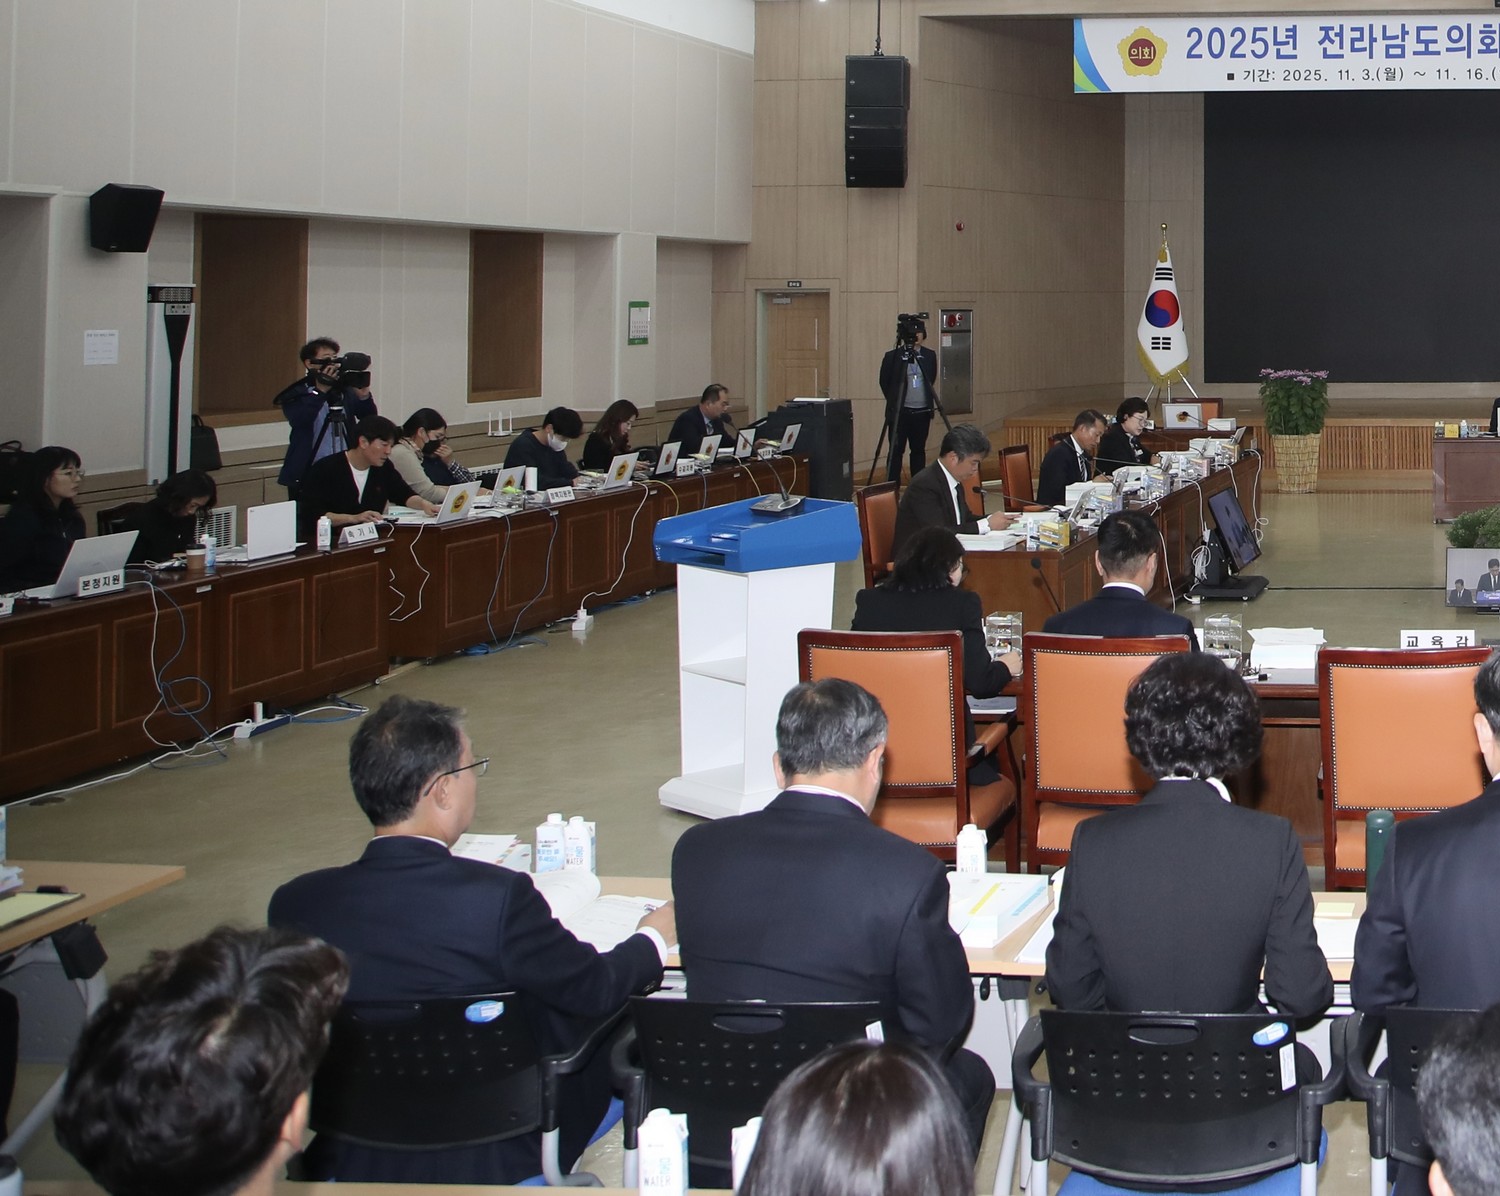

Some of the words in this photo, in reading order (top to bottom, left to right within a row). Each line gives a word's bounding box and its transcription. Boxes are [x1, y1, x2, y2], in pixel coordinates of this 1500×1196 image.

[1186, 24, 1298, 60] 2025년
[1129, 46, 1155, 60] 의회
[1243, 69, 1276, 83] 기간:
[1283, 69, 1328, 82] 2025.
[1338, 69, 1355, 82] 11.
[1436, 68, 1456, 80] 11.
[82, 574, 121, 592] 본청지원
